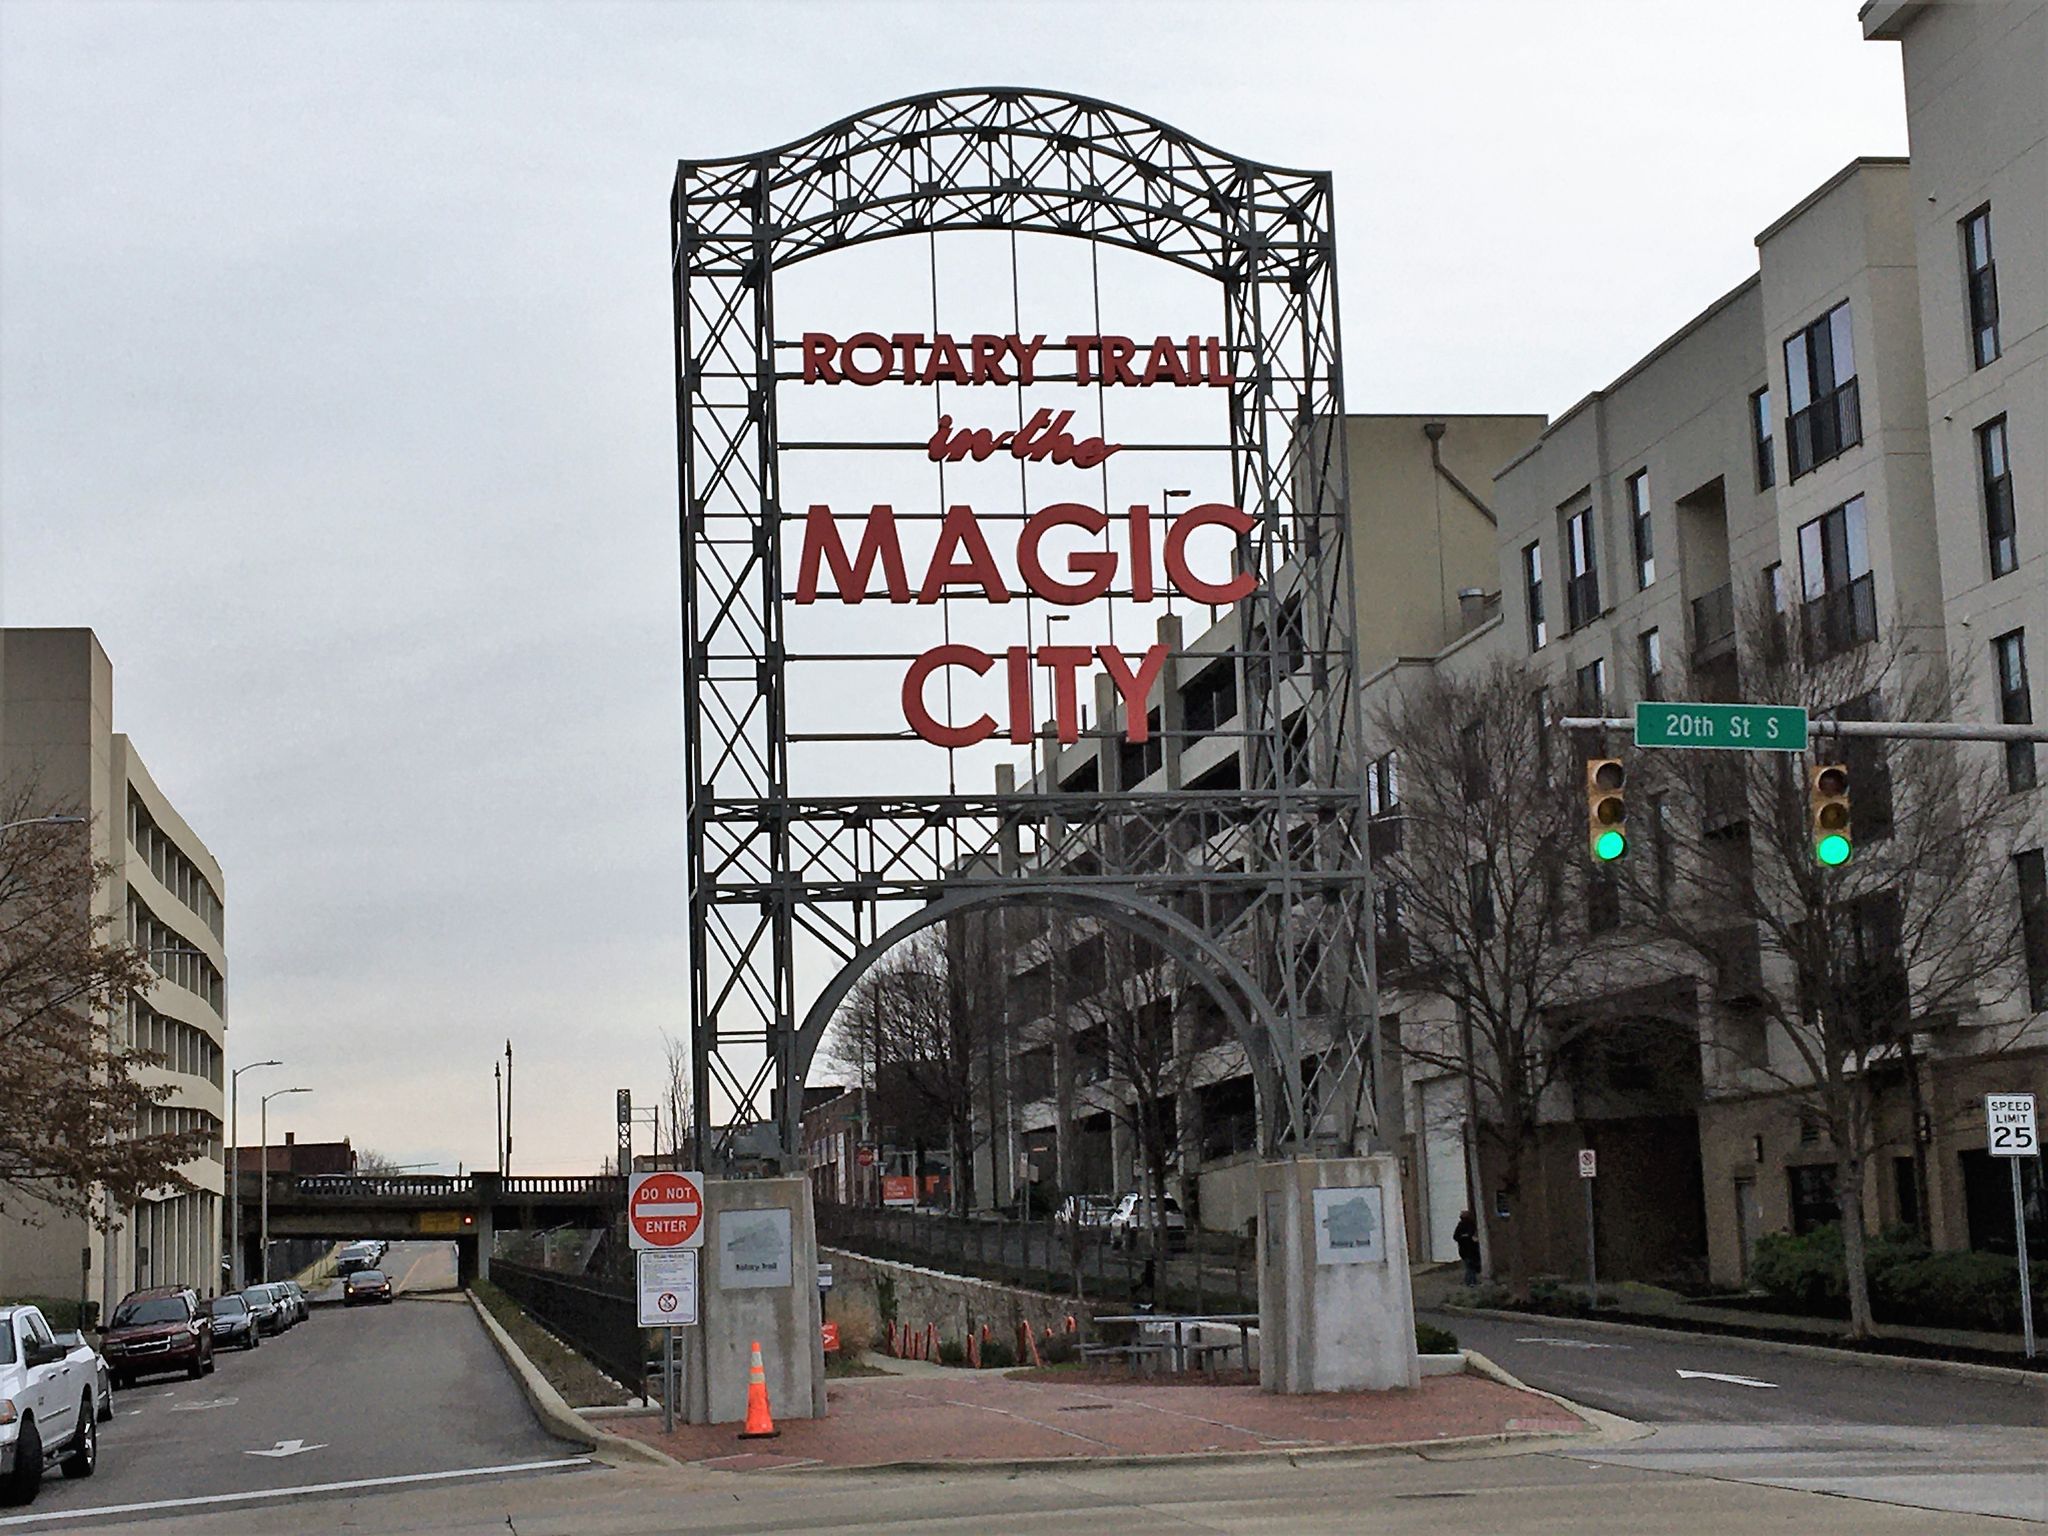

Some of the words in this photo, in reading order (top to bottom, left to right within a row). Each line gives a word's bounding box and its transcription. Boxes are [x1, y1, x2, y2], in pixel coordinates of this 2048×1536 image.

[802, 332, 1047, 387] ROTARY
[1065, 334, 1236, 388] TRAIL
[927, 413, 1010, 463] in
[1011, 407, 1122, 469] the
[795, 502, 1260, 606] MAGIC
[901, 643, 1171, 749] CITY
[1666, 713, 1714, 737] 20th
[1729, 715, 1751, 738] St
[1767, 717, 1778, 739] S
[1991, 1102, 2031, 1111] SPEED
[1996, 1114, 2027, 1123] LIMIT
[1994, 1127, 2032, 1148] 25
[641, 1187, 659, 1201] DO
[666, 1186, 692, 1200] NOT
[646, 1220, 687, 1233] ENTER
